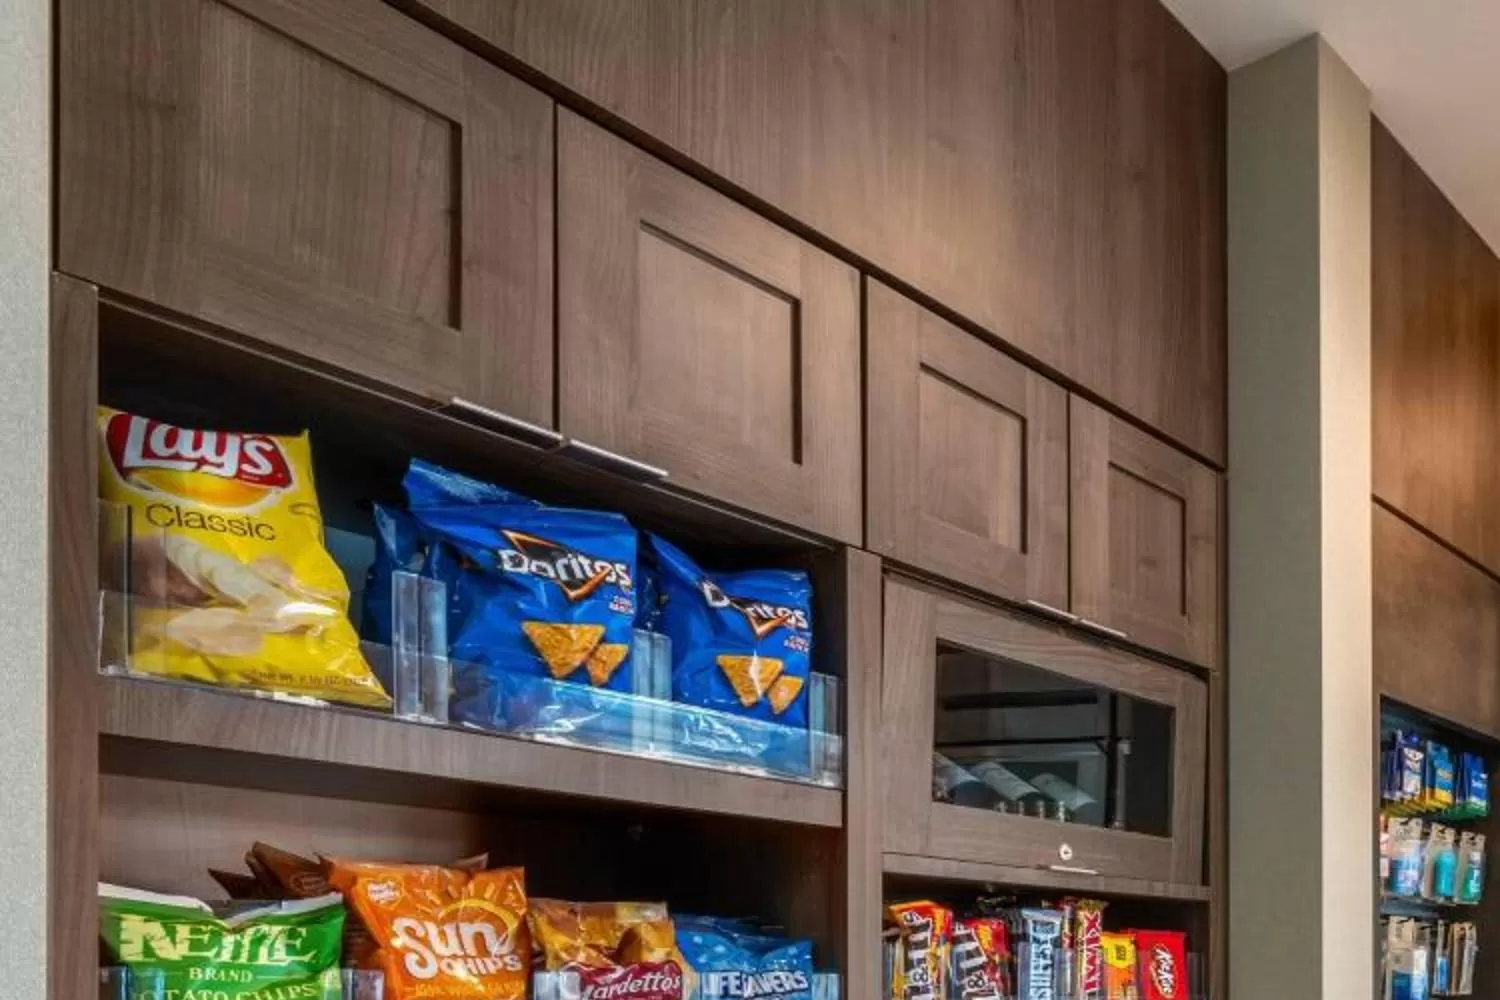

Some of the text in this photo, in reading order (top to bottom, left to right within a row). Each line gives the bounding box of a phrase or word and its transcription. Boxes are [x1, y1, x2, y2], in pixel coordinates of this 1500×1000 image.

[145, 502, 276, 542] Classic
[497, 547, 633, 590] Doritos
[702, 580, 809, 631] Dritos
[391, 916, 514, 980] Sun
[188, 967, 253, 984] BRAND
